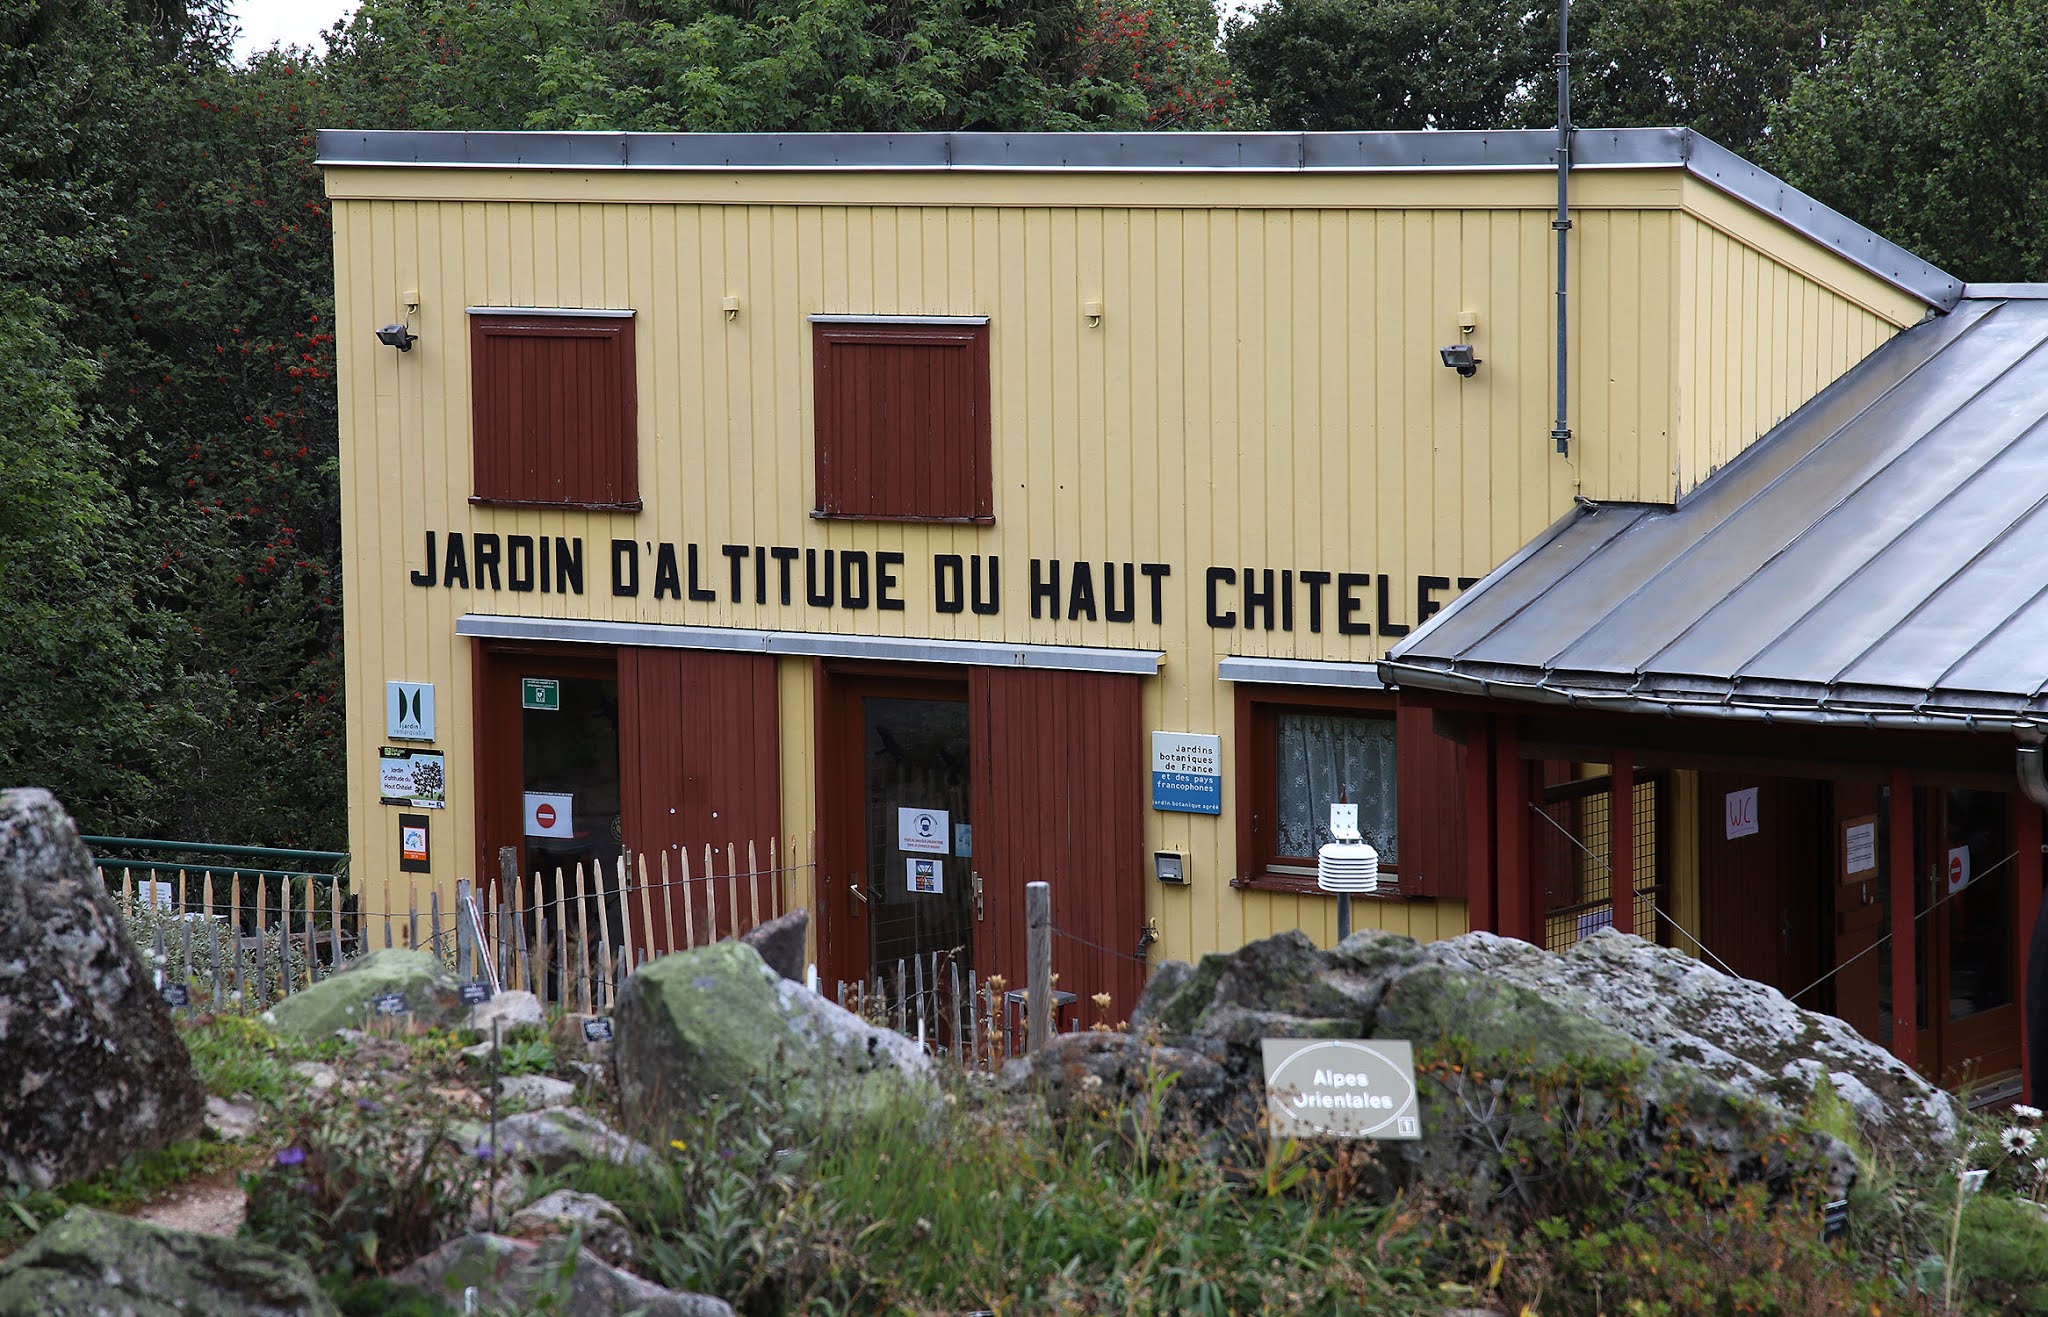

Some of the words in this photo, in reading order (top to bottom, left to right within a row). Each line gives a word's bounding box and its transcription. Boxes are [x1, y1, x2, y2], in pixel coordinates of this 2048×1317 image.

[410, 530, 585, 595] JARDIN
[611, 539, 905, 612] D'ALTITUDE
[934, 554, 1000, 616] DU
[1030, 558, 1171, 626] HAUT
[1176, 745, 1213, 754] Jardins
[1160, 752, 1213, 764] botaniques
[1165, 762, 1176, 771] de
[1181, 763, 1213, 773] France
[1161, 773, 1171, 781] et
[1175, 774, 1190, 782] des
[1194, 776, 1213, 784] pays
[1157, 781, 1213, 792] francophones
[1172, 801, 1201, 809] botanique
[1314, 1069, 1369, 1088] Alpes
